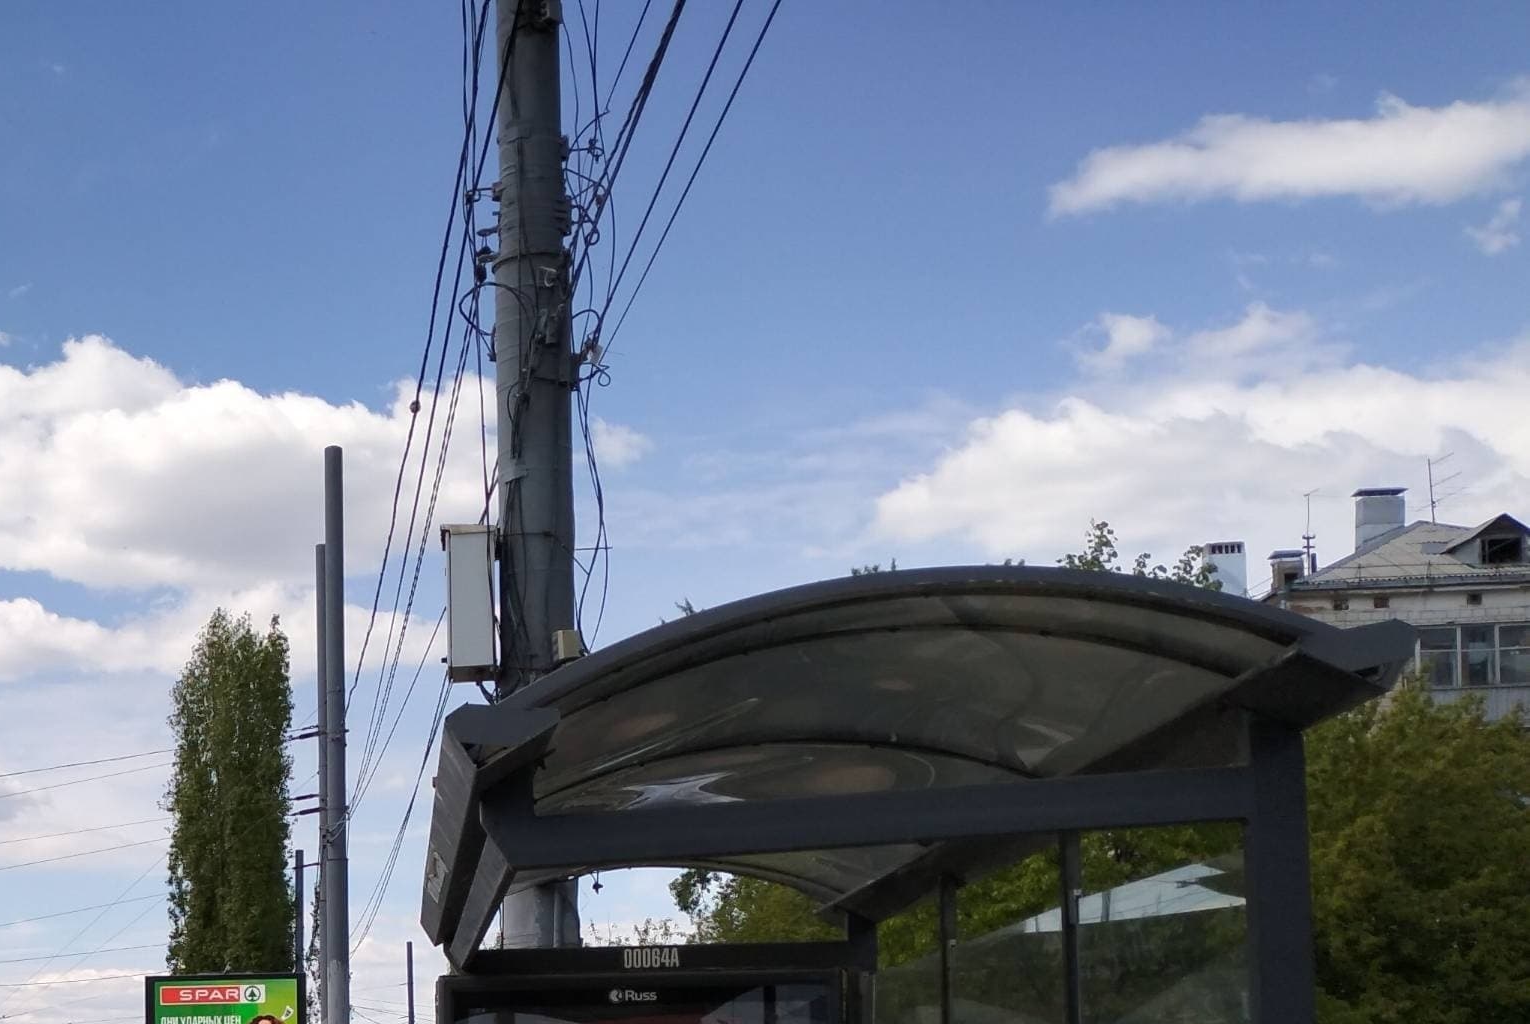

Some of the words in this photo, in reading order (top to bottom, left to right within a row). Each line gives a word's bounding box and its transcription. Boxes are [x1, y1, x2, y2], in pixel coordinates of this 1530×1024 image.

[623, 947, 680, 969] 00064A
[179, 988, 239, 1001] SPAR
[624, 989, 658, 1001] Russ
